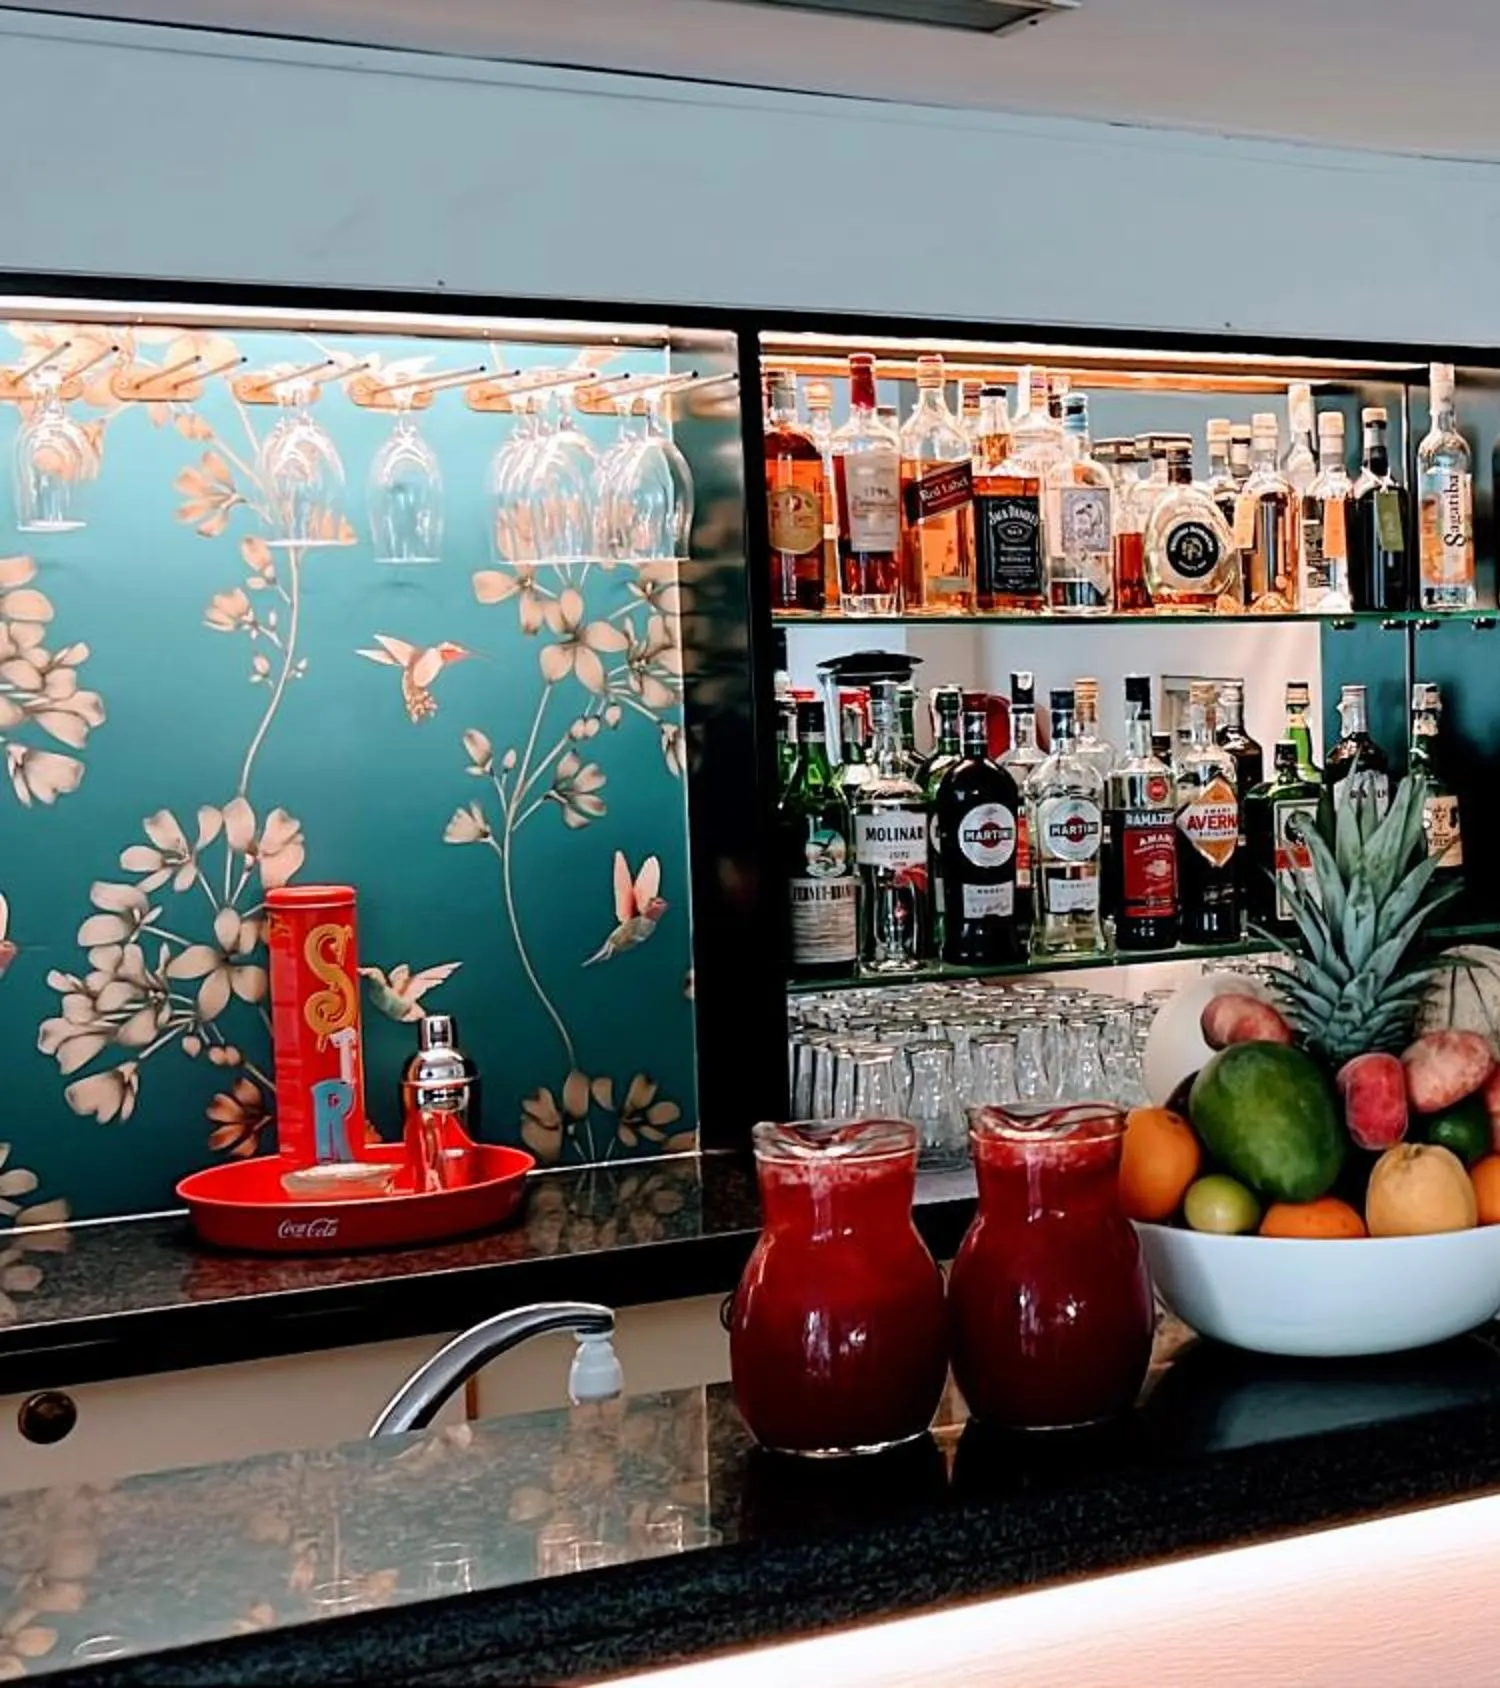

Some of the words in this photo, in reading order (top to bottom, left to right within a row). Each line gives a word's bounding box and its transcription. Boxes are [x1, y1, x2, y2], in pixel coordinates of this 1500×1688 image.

[920, 484, 941, 501] Red
[942, 475, 969, 494] Label
[1443, 474, 1466, 548] Sagatiba
[278, 1217, 340, 1239] Coca-Cola
